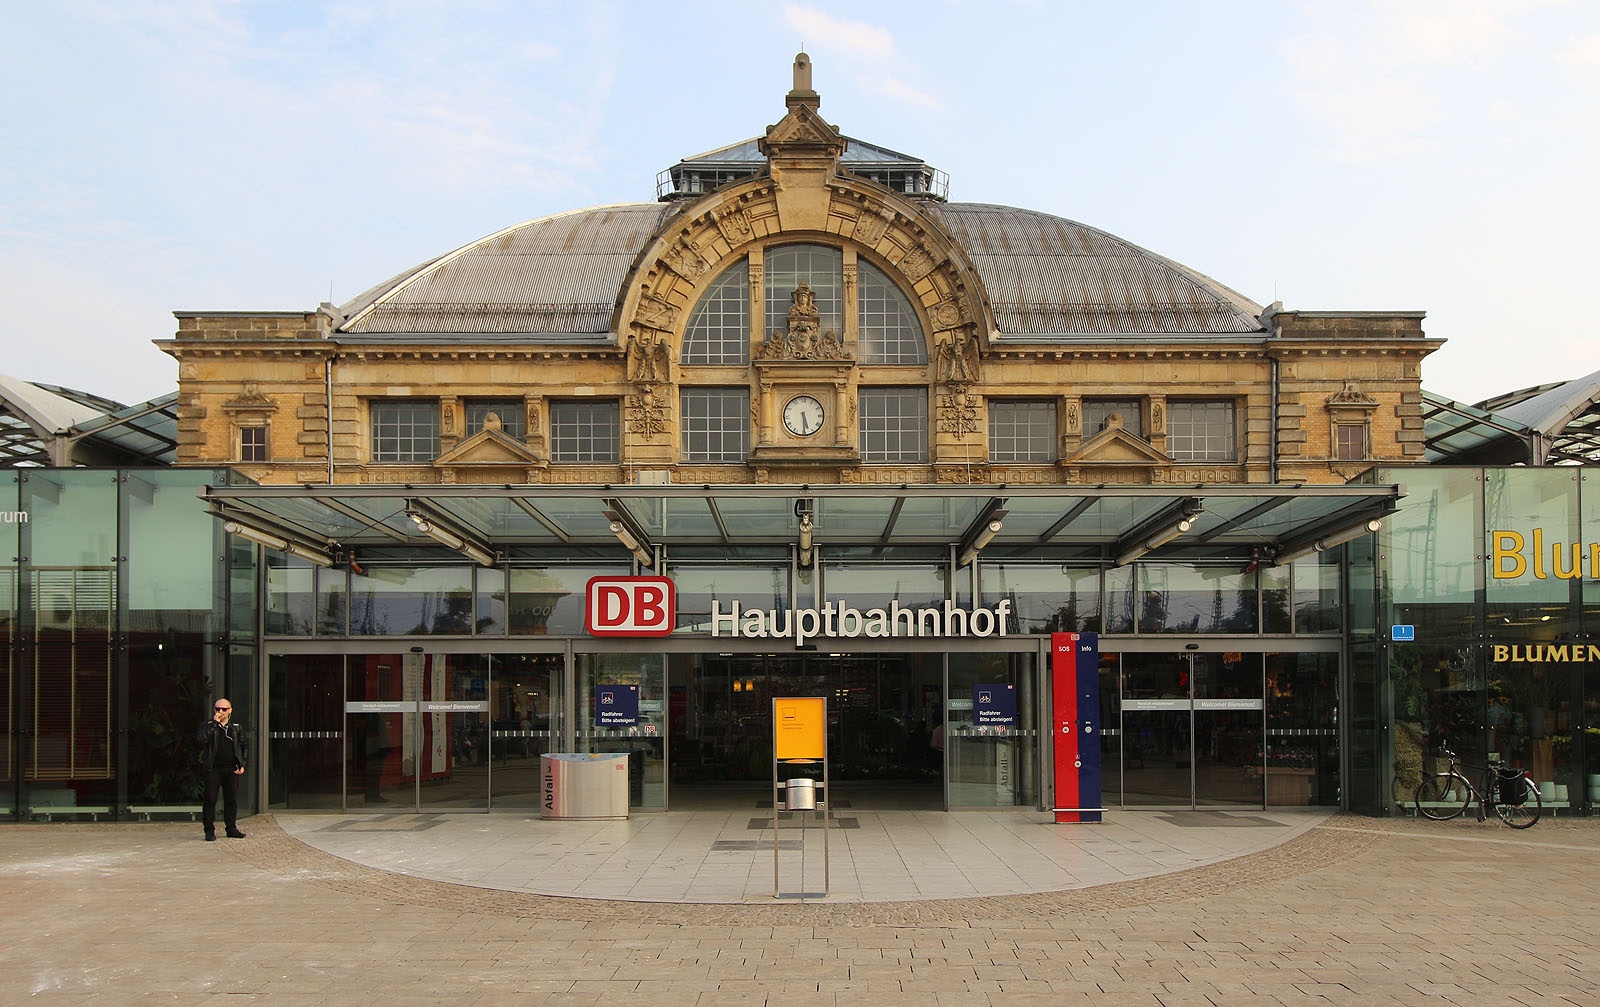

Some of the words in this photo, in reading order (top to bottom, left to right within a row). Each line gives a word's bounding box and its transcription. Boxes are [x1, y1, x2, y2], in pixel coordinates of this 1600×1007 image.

[598, 586, 665, 627] DB
[711, 599, 1011, 646] Hauptbahnhof
[1000, 758, 1008, 787] Abfall
[545, 775, 553, 810] Abfall
